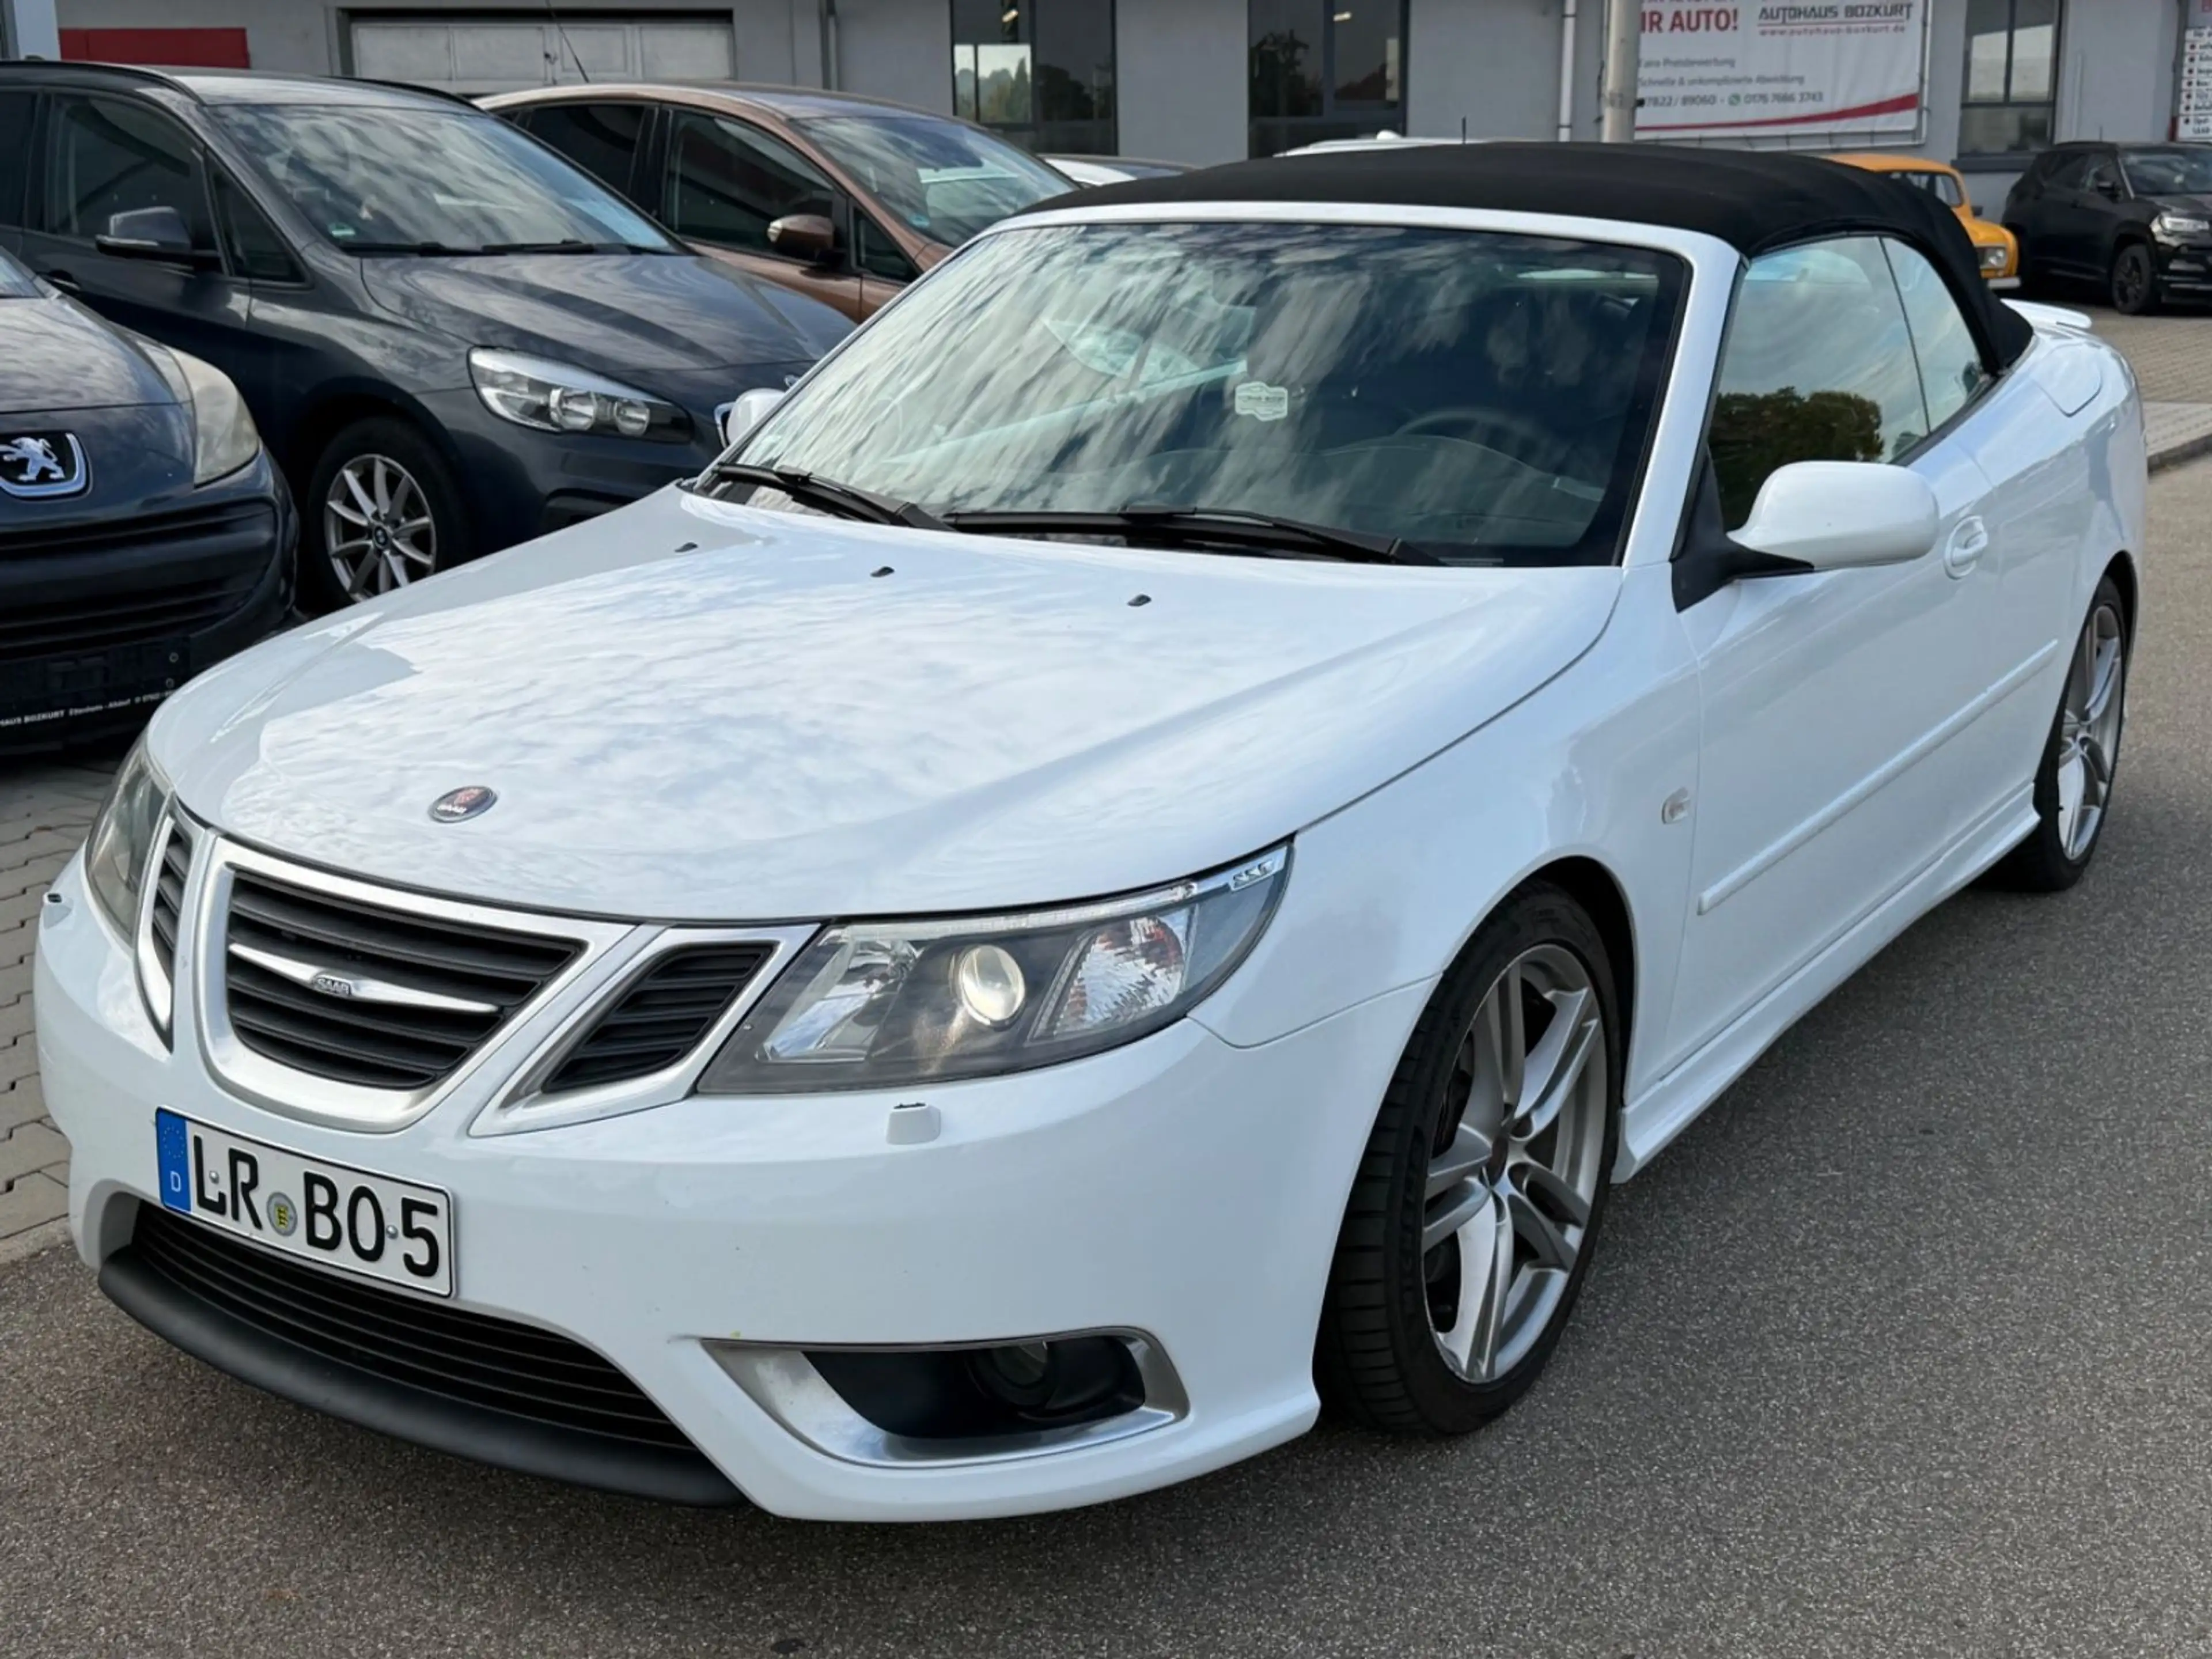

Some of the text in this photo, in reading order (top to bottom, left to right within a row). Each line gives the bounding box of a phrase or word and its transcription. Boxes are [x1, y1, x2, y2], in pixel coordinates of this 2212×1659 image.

[1670, 8, 1738, 33] AUTO!
[1759, 2, 1912, 23] AUTOHAUS BOZKURT
[171, 1171, 182, 1192] D
[194, 1135, 263, 1230] LR
[402, 1197, 440, 1277] 5
